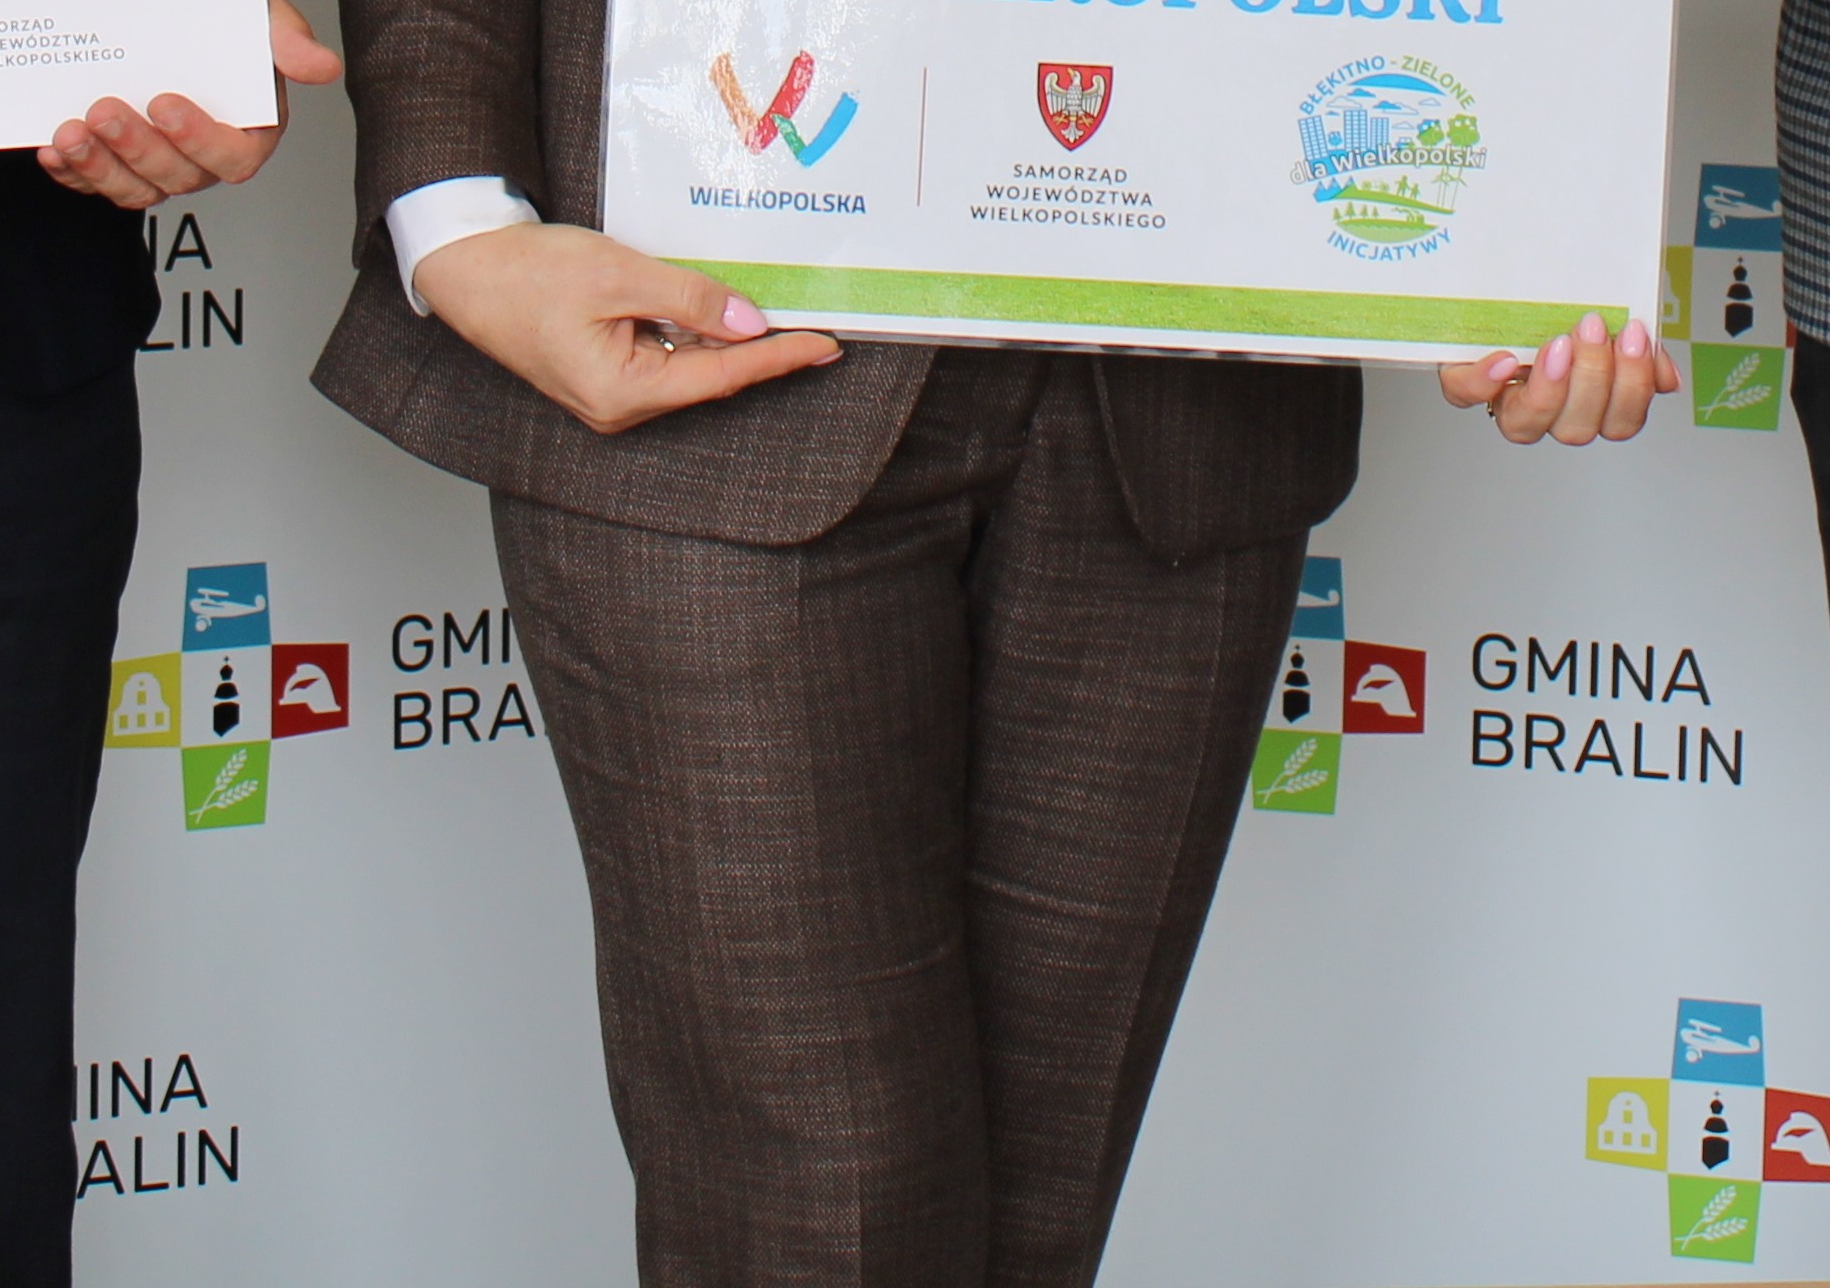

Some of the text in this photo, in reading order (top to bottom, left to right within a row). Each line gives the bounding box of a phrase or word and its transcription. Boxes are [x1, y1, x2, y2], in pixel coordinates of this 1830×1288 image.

[1299, 55, 1386, 116] BŁĘKITNO
[1400, 54, 1477, 110] ZIELONE
[985, 182, 1154, 208] WOJEWÓDZTWA
[1012, 162, 1128, 185] SAMORZĄD
[1289, 143, 1488, 185] dla Wielkopolski
[688, 185, 868, 215] WIELKOPOLSKA
[969, 205, 1167, 230] WIELKOPOLSKIEGO
[1326, 227, 1453, 262] INICJATYWY
[392, 607, 510, 673] GMI
[1471, 633, 1712, 707] GMINA
[393, 683, 536, 751] BRA
[1470, 709, 1744, 786] BRALIN
[74, 1053, 209, 1122] INA
[76, 1125, 240, 1200] ALIN
